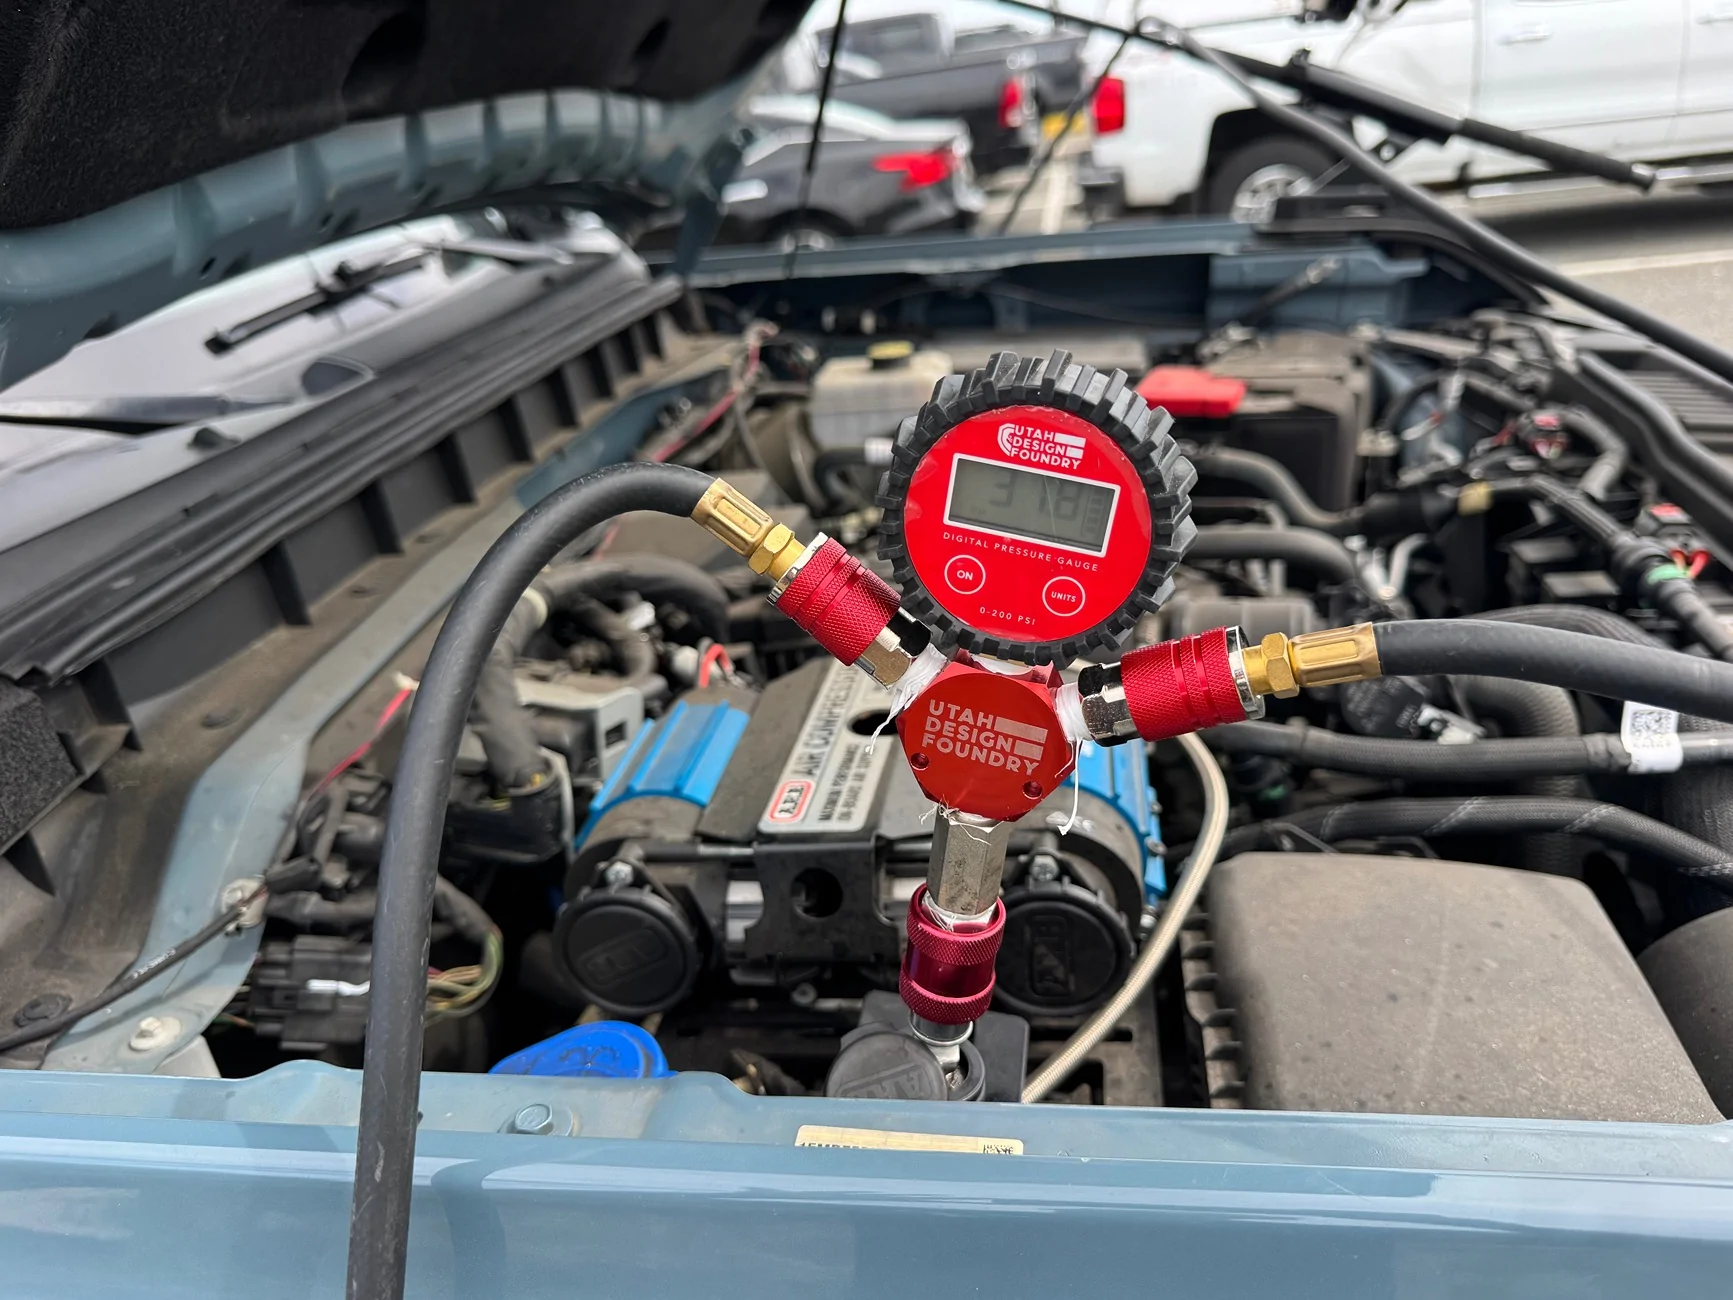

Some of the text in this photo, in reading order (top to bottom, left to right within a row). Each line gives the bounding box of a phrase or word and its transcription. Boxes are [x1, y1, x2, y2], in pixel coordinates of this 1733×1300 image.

[1014, 424, 1055, 442] UTAH
[1012, 436, 1066, 456] DESIGN
[1010, 447, 1081, 470] FOUNDRY
[943, 531, 1099, 572] DIGITAL PRESSURE GAUGE
[956, 569, 974, 581] ON
[1051, 590, 1077, 603] UNITS
[979, 606, 1036, 626] 0-200 PSI
[929, 699, 994, 730] UTAH
[924, 715, 1013, 753] DESIGN
[921, 732, 1040, 776] FOUNDRY
